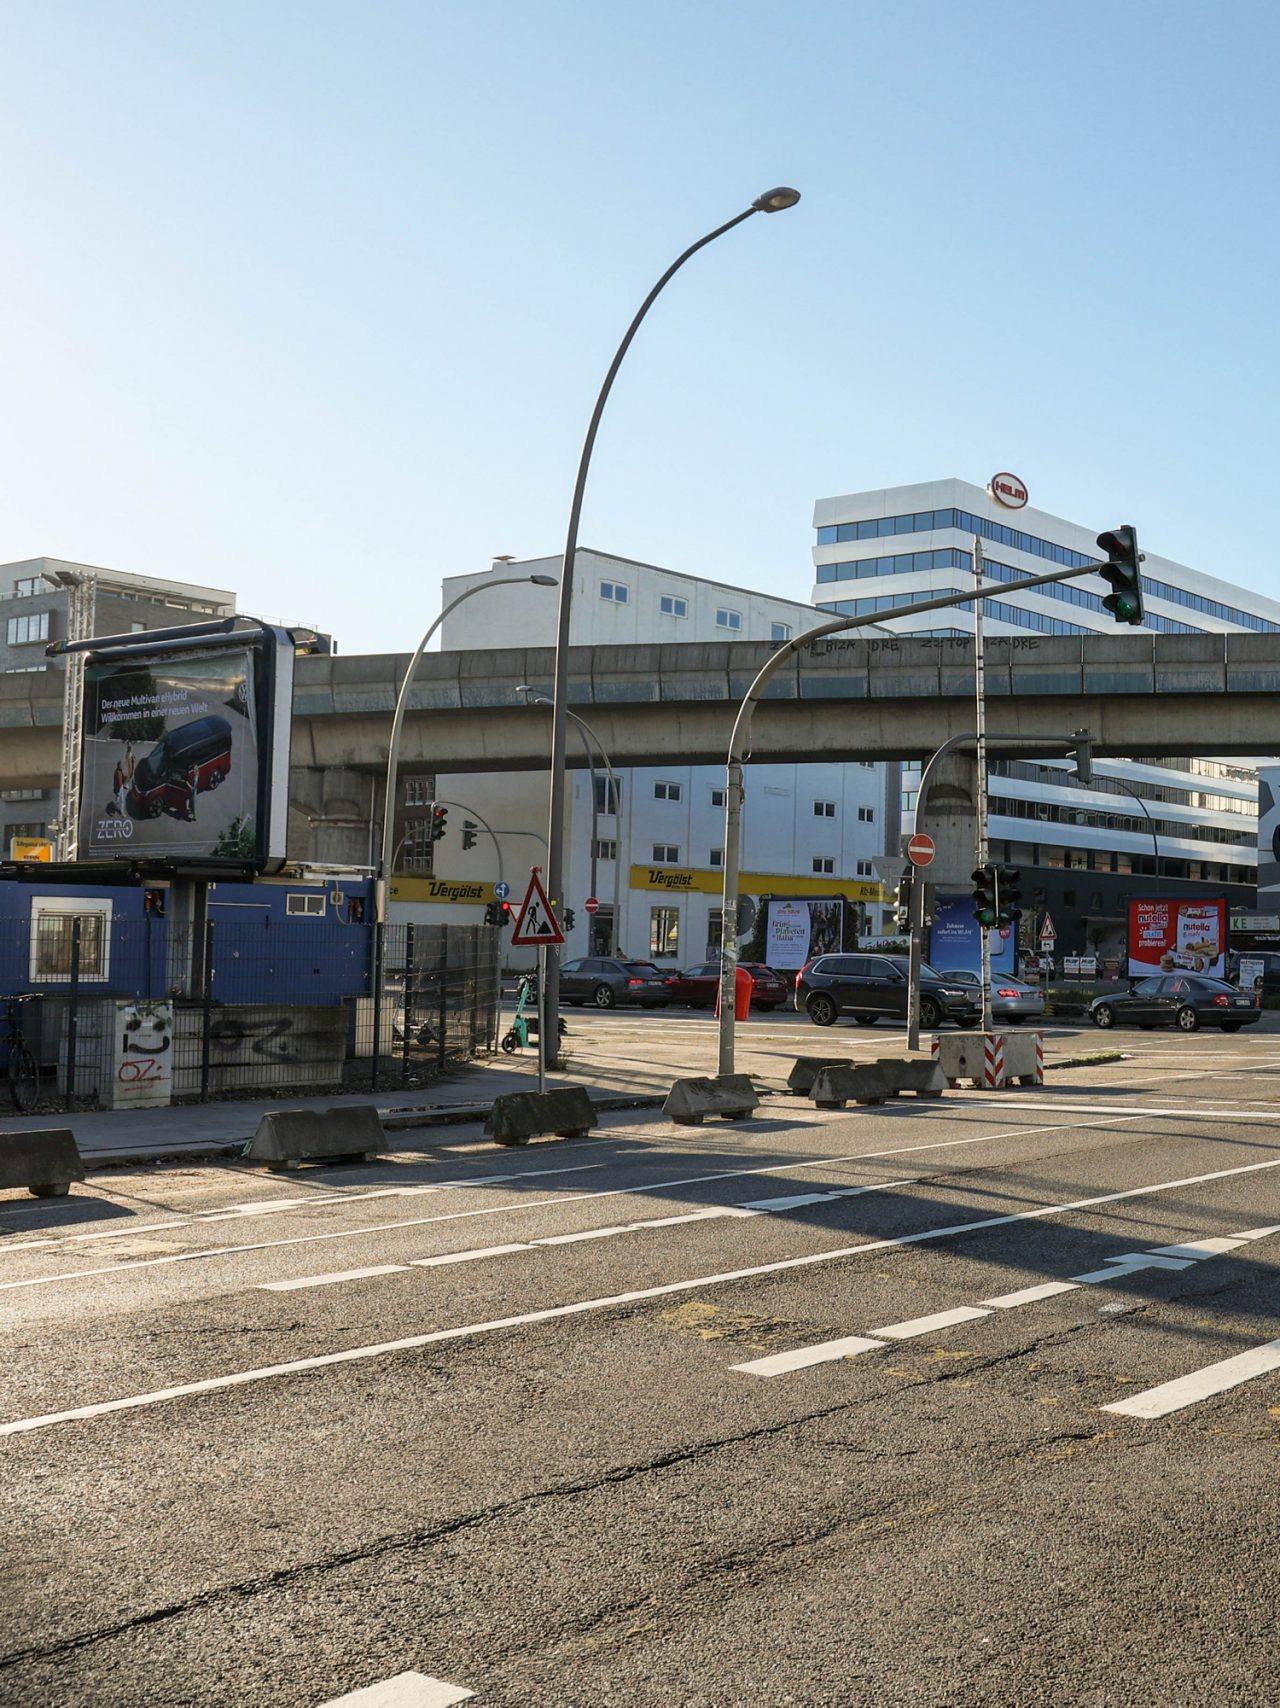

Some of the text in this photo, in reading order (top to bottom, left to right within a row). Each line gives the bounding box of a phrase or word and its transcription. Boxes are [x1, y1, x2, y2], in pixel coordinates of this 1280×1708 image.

[995, 480, 1025, 501] HELM
[871, 640, 899, 651] DRE
[947, 638, 970, 649] TOP
[1012, 638, 1040, 650] DRE
[102, 690, 188, 710] Der neue Multivan eHybrid
[101, 703, 209, 723] Willkommen in einer neuen Welt
[97, 819, 134, 839] ZERO
[648, 870, 693, 888] Vergölst
[429, 882, 484, 901] Vergölst
[1138, 904, 1168, 912] Schon jetzt
[1138, 913, 1168, 923] nutella
[1183, 922, 1210, 931] nutella
